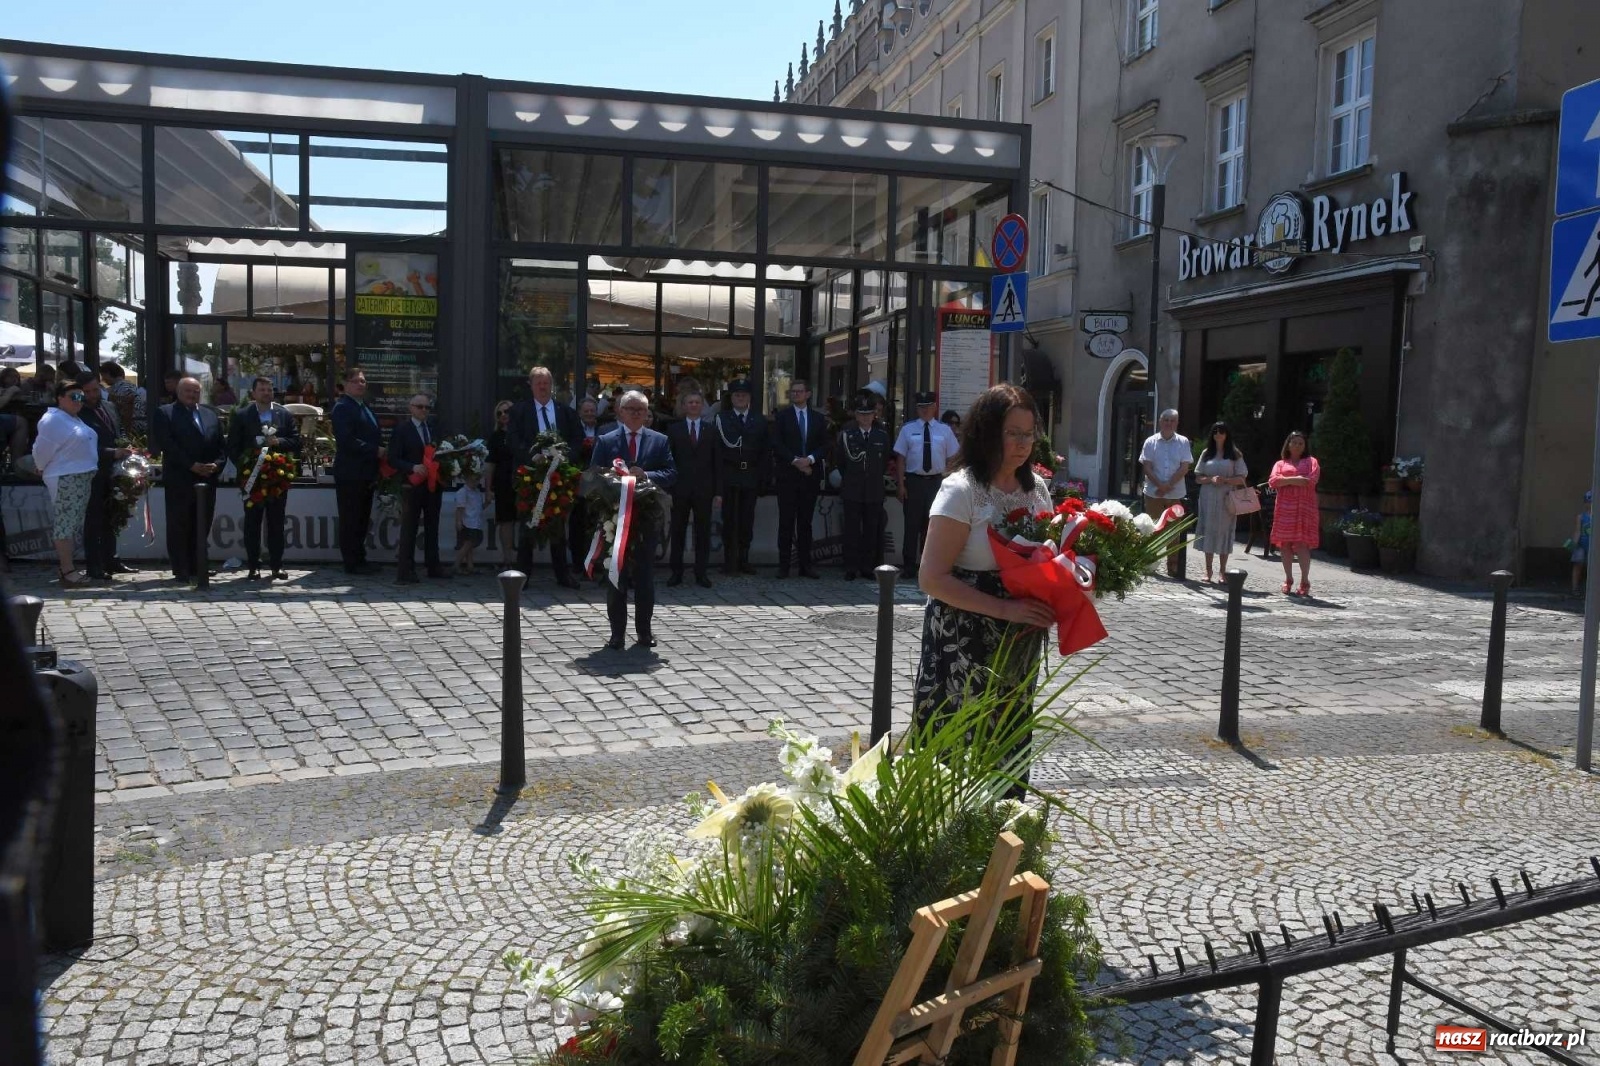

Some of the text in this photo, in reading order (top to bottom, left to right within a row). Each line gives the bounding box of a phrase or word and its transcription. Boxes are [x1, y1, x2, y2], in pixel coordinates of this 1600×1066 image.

[1178, 172, 1412, 281] Browar Rynek
[357, 297, 390, 314] CATERING
[390, 319, 404, 329] BEZ
[949, 313, 986, 325] LUNCH
